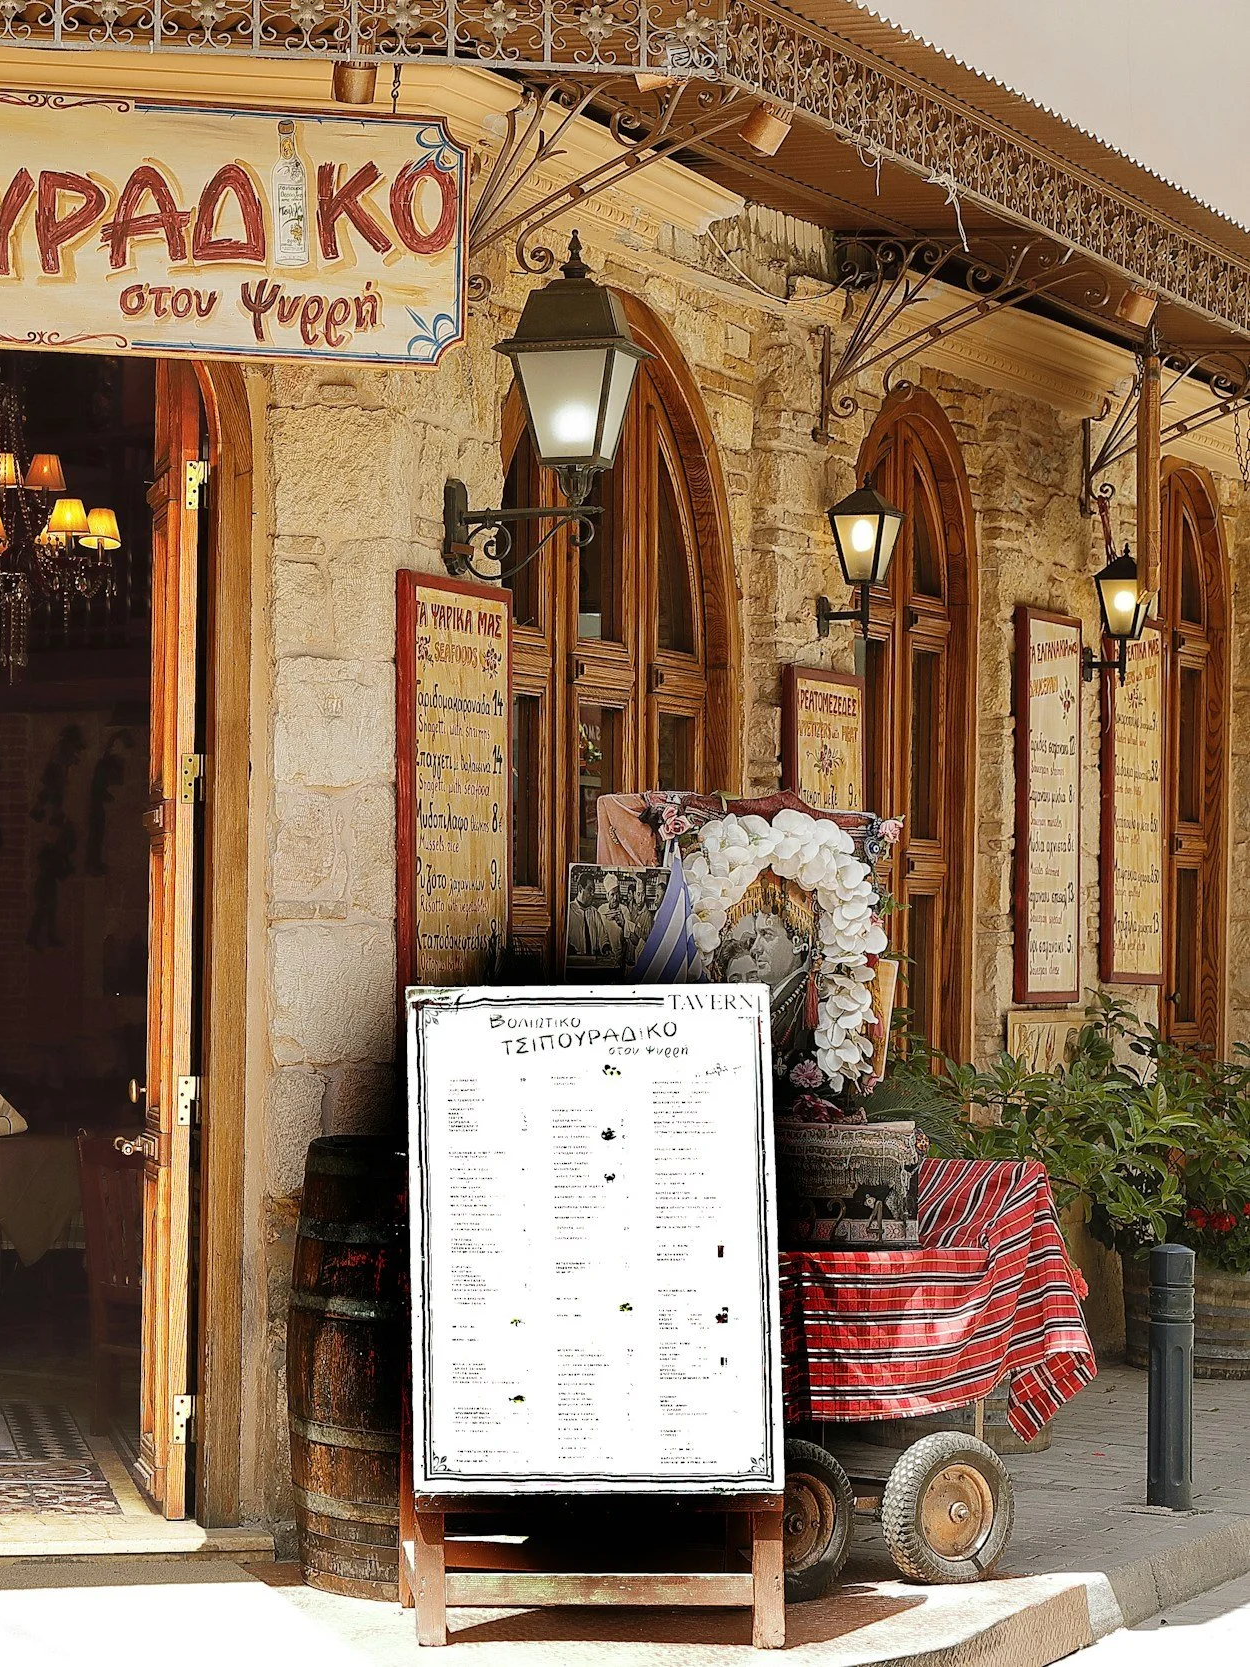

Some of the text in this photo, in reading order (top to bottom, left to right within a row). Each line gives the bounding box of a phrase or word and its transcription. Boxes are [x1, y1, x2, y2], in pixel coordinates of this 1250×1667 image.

[121, 284, 217, 317] στον
[431, 603, 474, 634] ΨΑΡΙΚΑ
[477, 611, 502, 640] ΜΑΣ
[434, 641, 478, 668] SEAFOODS
